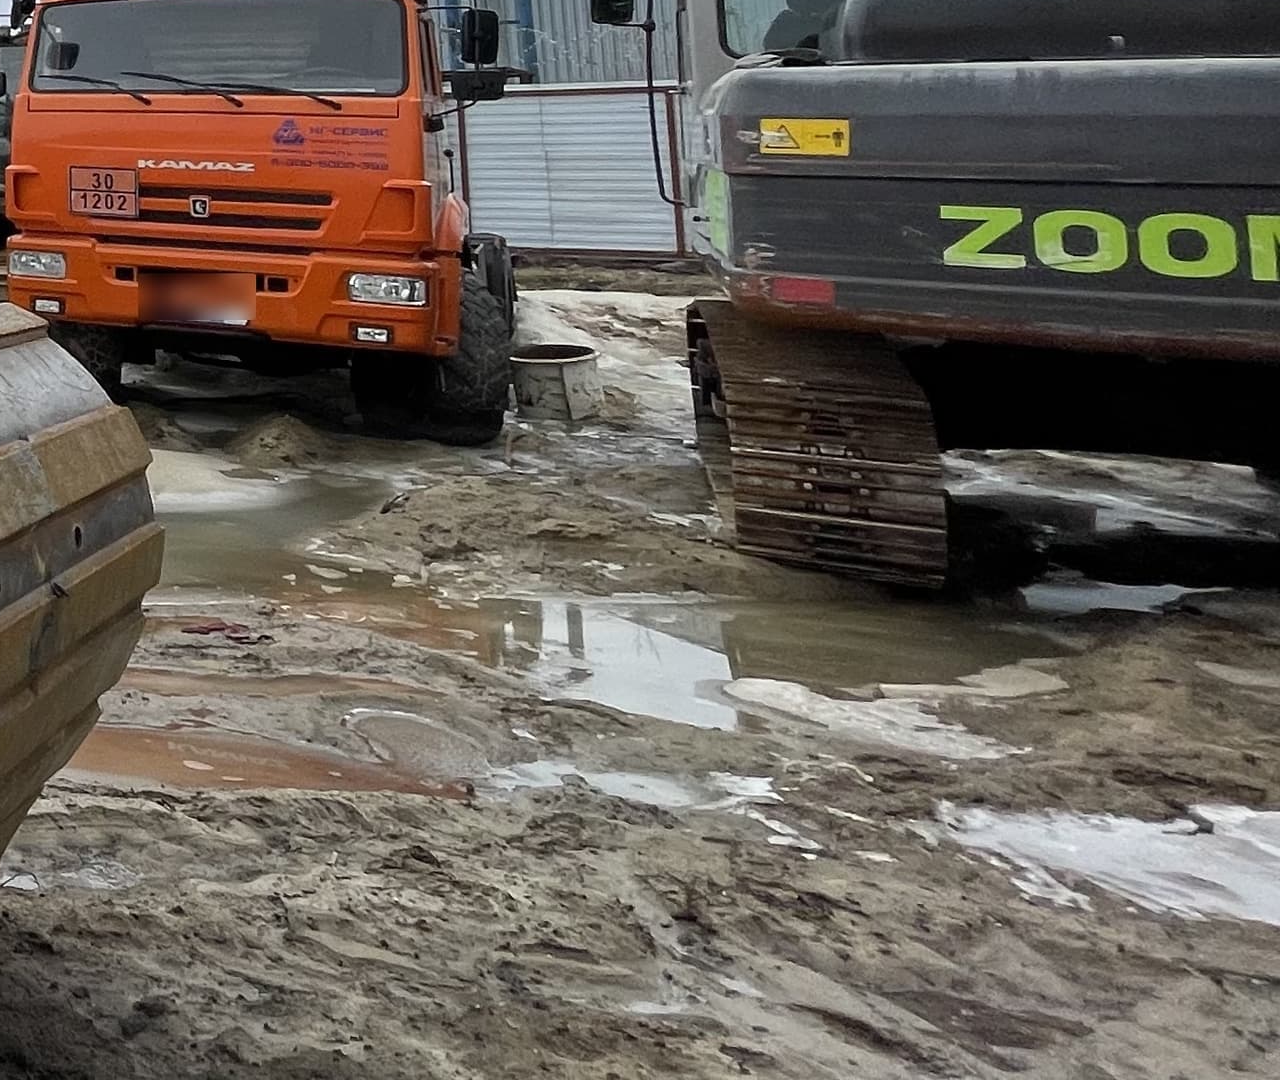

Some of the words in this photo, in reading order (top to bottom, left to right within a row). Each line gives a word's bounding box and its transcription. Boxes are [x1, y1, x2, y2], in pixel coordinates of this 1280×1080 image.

[137, 159, 255, 172] KAMAZ
[92, 173, 114, 190] 30
[79, 194, 128, 211] 1202
